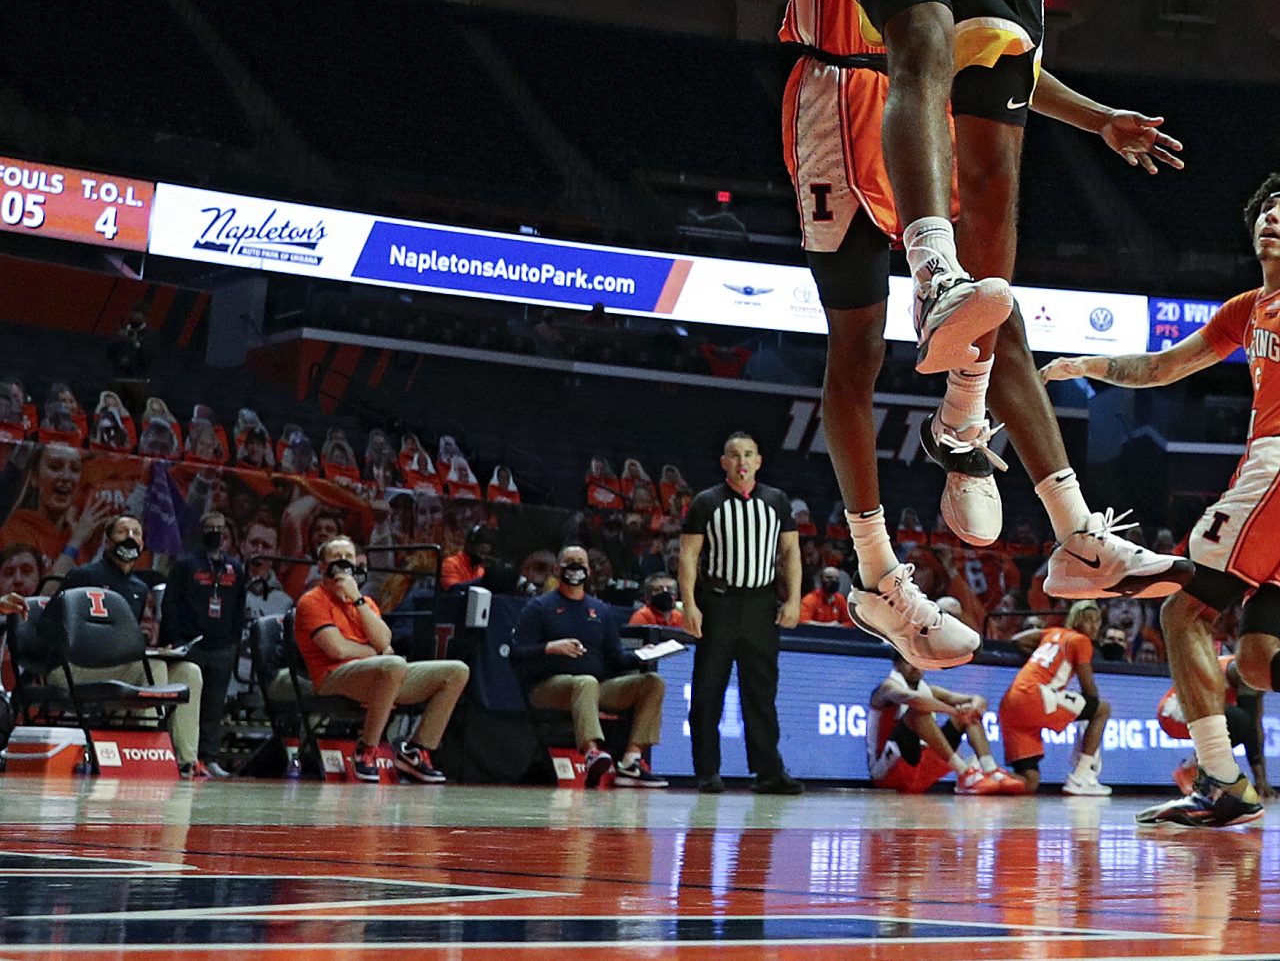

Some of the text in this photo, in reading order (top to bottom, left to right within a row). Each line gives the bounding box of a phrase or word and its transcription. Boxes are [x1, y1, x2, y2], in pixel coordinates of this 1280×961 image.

[81, 178, 144, 208] T.O.L.
[1, 191, 118, 241] 05 4
[201, 207, 328, 255] Napleton's
[388, 244, 636, 295] NapletonsAutoPark.com
[818, 703, 867, 737] BIG
[1104, 719, 1146, 750] BIG
[123, 748, 176, 762] TOYOTA
